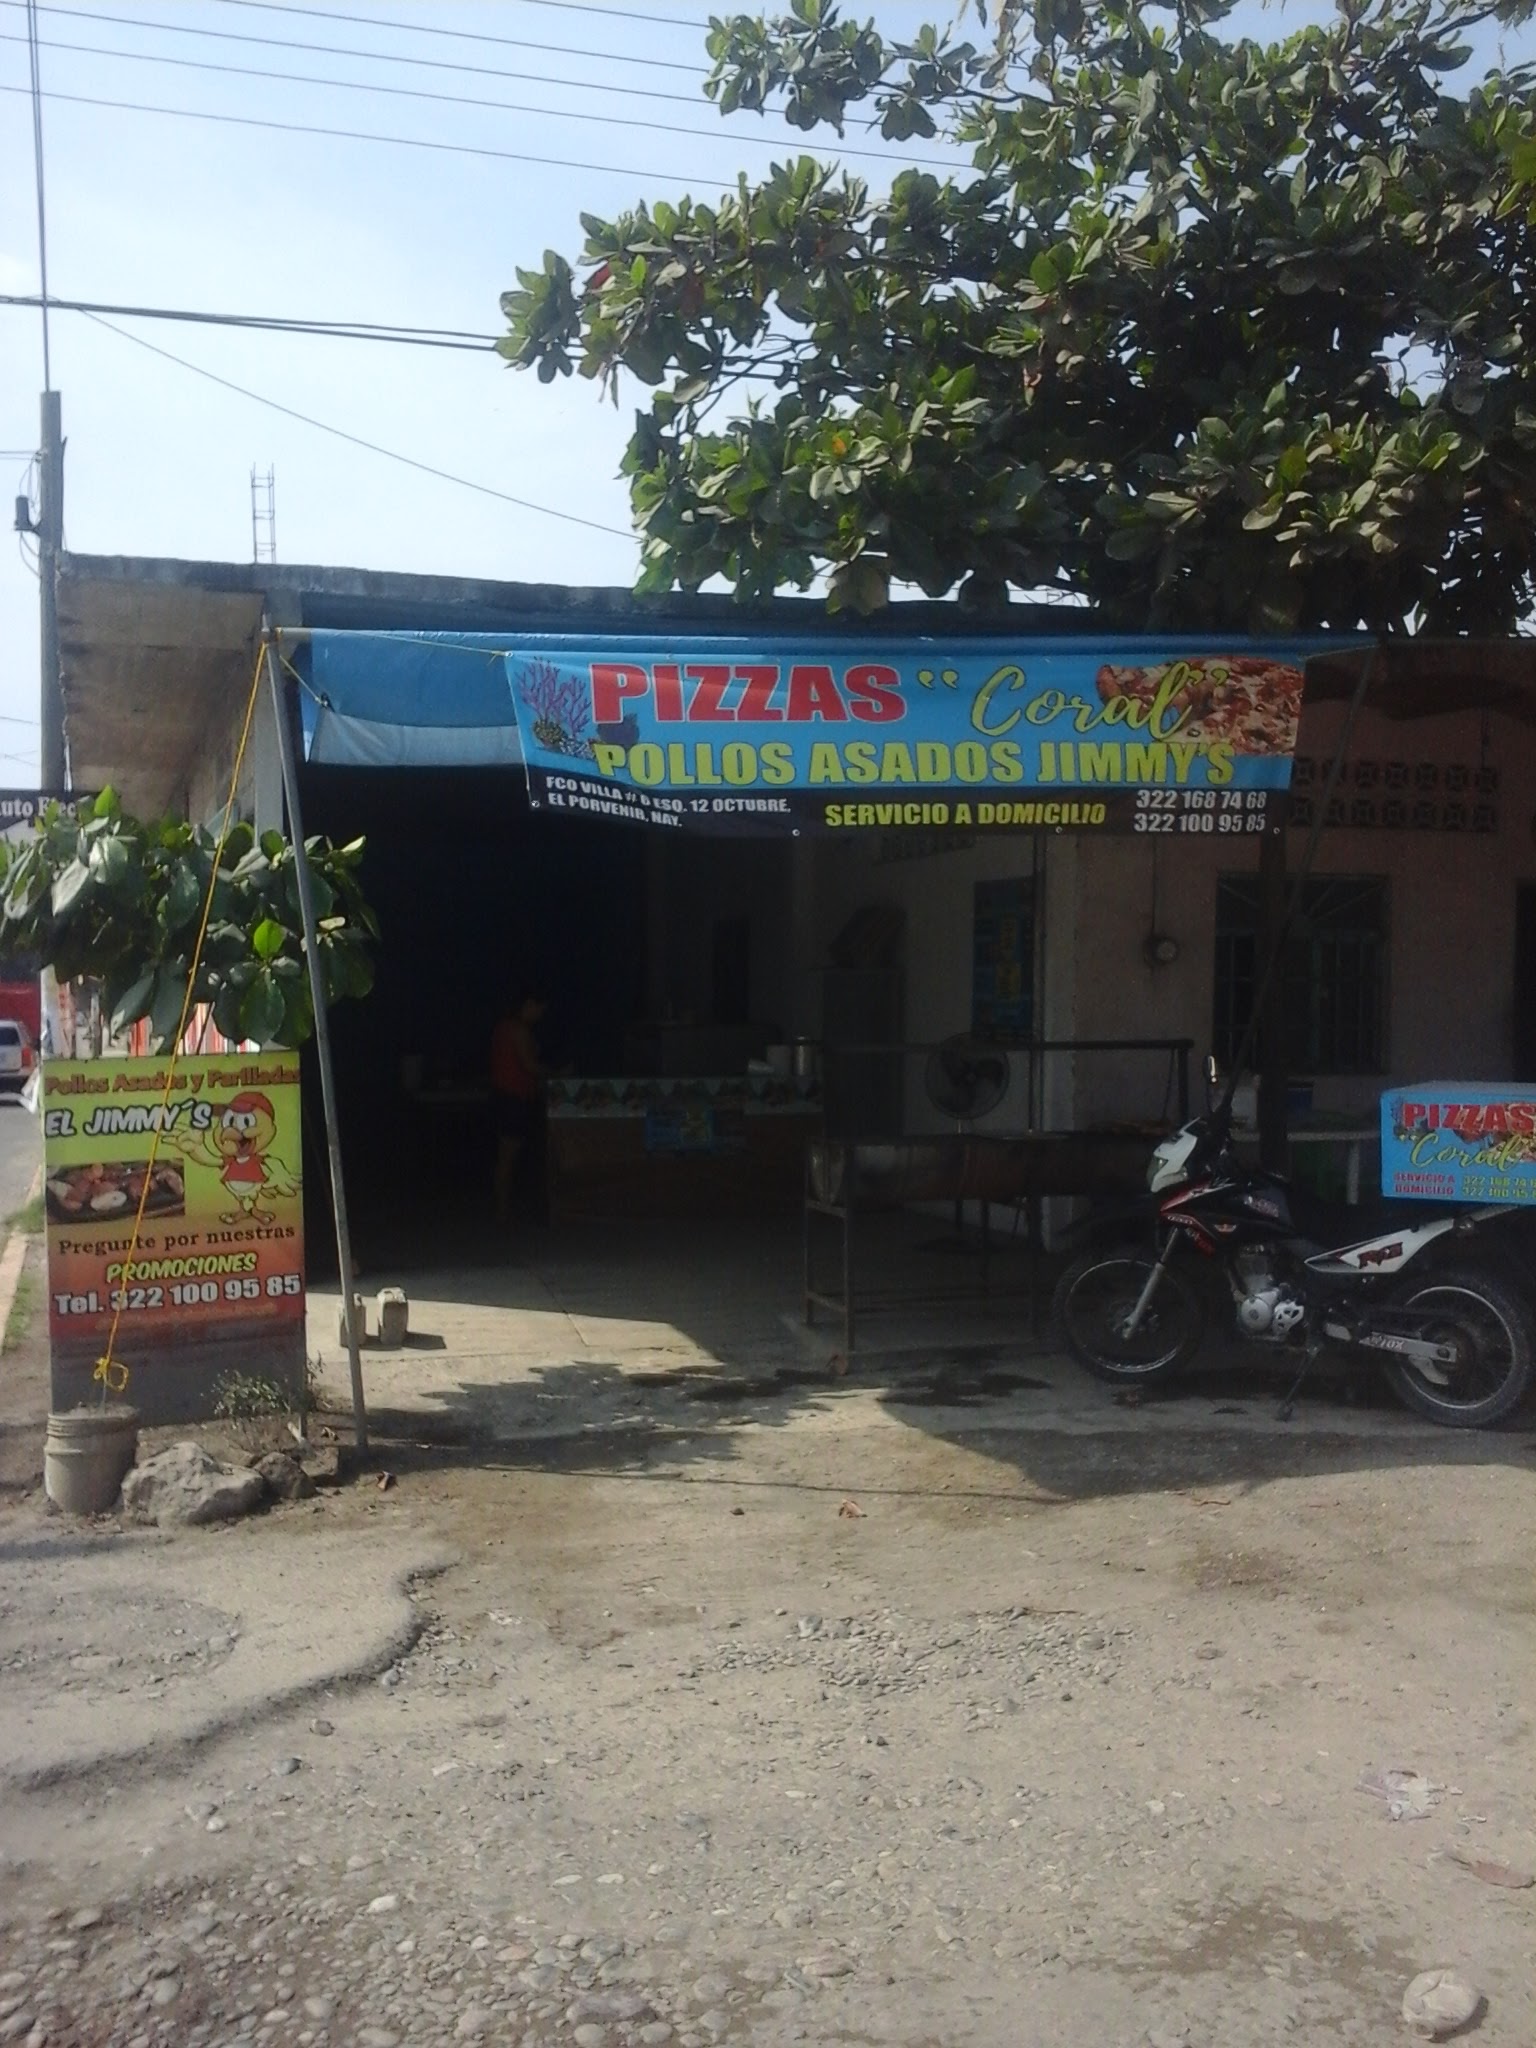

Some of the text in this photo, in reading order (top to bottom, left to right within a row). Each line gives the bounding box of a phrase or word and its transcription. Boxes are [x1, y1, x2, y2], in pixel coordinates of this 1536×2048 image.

[590, 663, 907, 724] PIZZAS
[594, 741, 1235, 786] POLLOS ASADOS JIMMY'S
[0, 798, 33, 817] uto
[546, 776, 577, 792] FCO
[580, 781, 623, 800] VILLA
[691, 799, 709, 812] 12
[1136, 789, 1178, 809] 322
[1182, 790, 1217, 809] 168
[1220, 791, 1243, 809] 74
[548, 792, 566, 806] EL
[651, 810, 683, 827] NAY.
[824, 803, 1107, 827] SERVICIO A DOMICILIO
[1134, 813, 1266, 832] 322 100 95 85
[45, 1073, 109, 1096] Pollos
[112, 1070, 187, 1092] Asados
[191, 1073, 204, 1093] y
[45, 1108, 77, 1137] EL
[1403, 1103, 1535, 1132] PIZZAS
[1394, 1172, 1444, 1183] SERVICIO
[1447, 1174, 1455, 1183] A
[59, 1226, 296, 1256] Pregunte por nuestras
[106, 1252, 258, 1284] PROMOCIONES
[54, 1274, 300, 1315] Tel. 322 100 95 85
